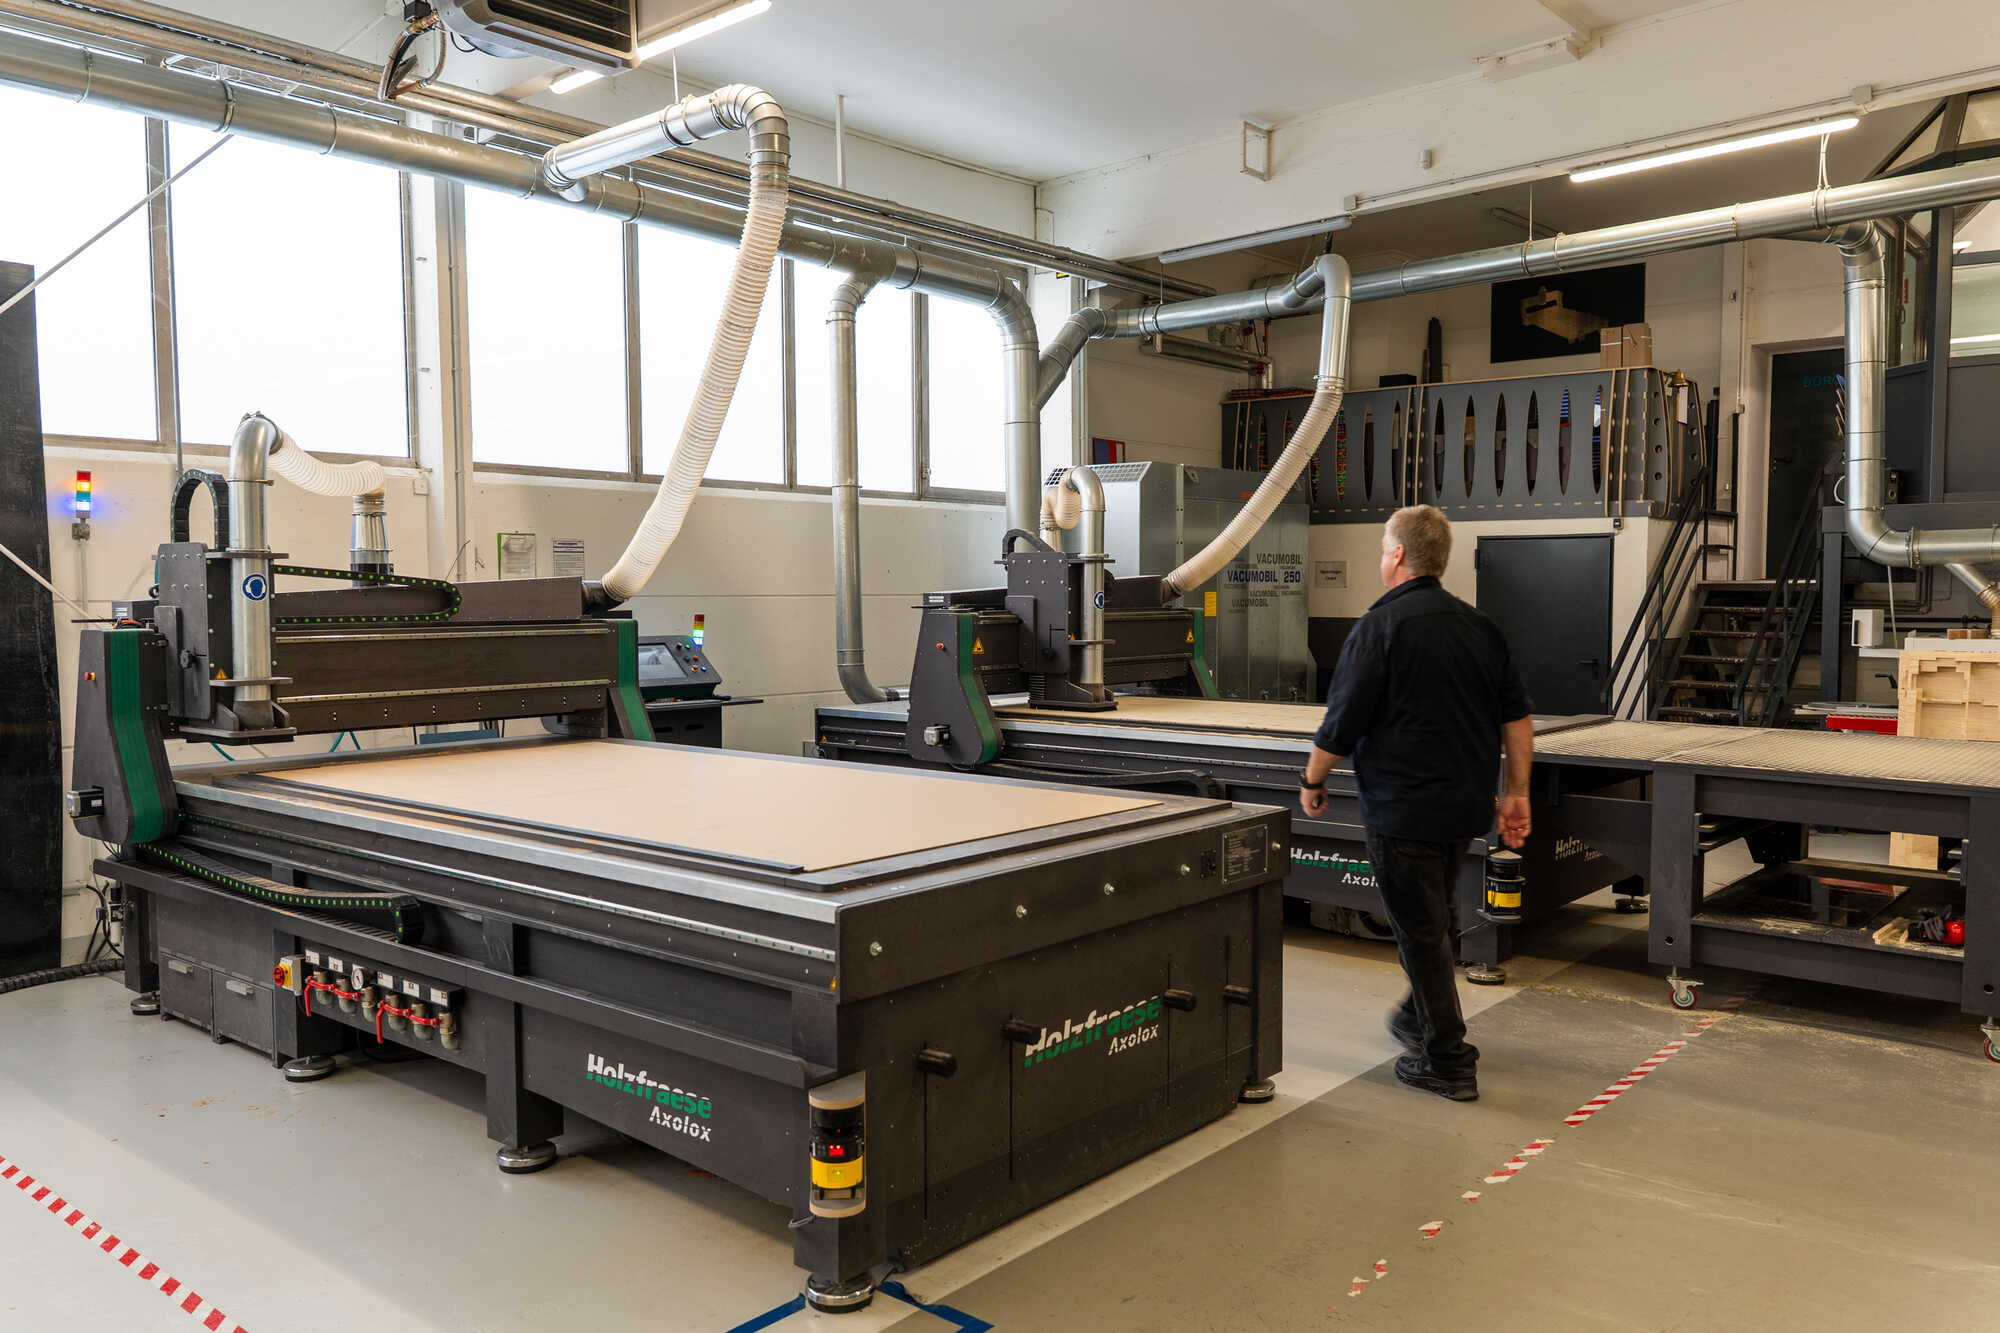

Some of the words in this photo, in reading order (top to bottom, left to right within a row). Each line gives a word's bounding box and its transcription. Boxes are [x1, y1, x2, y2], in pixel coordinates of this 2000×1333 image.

[1256, 553, 1302, 565] VACUMOBIL
[1227, 570, 1278, 583] VACUMOBIL
[1283, 571, 1301, 583] 250
[1289, 847, 1375, 874] Holzfrae
[1024, 995, 1160, 1068] Holzfraese
[1108, 1024, 1159, 1056] Axolox
[586, 1053, 712, 1119] Holzfraese
[649, 1105, 712, 1142] Axolox
